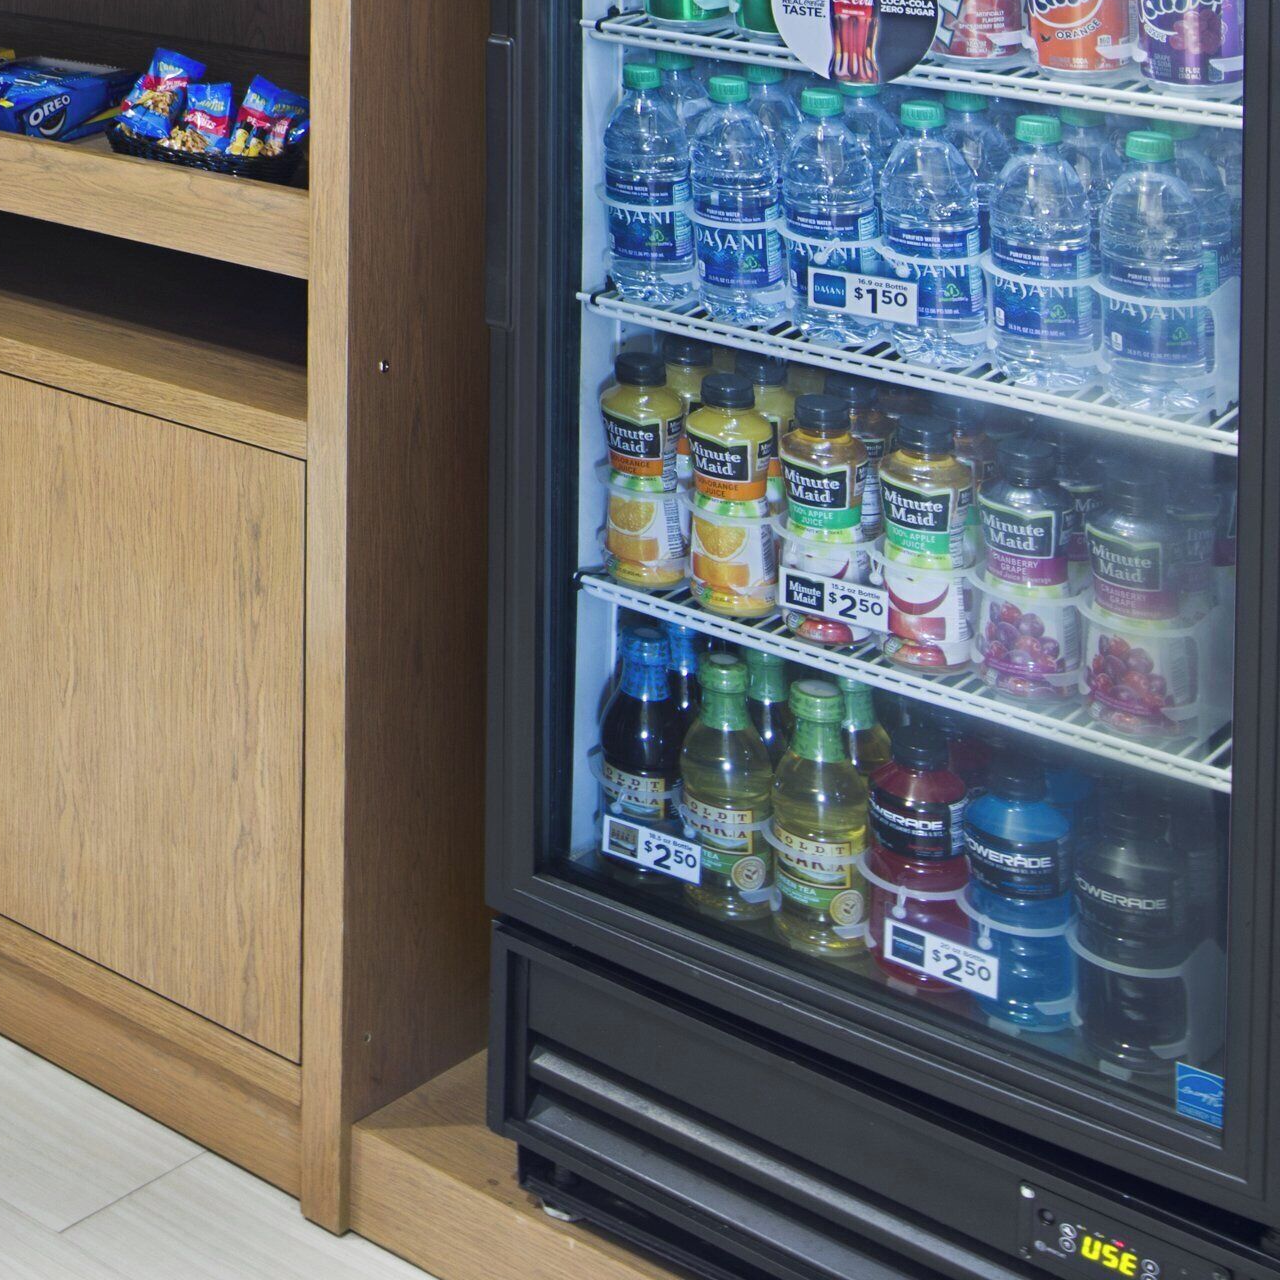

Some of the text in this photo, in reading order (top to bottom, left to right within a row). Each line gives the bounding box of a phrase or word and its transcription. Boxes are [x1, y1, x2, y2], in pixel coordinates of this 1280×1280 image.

[782, 4, 827, 19] TASTE.
[880, 4, 935, 17] ZERO SUGAR
[1055, 18, 1102, 40] ORANGE
[27, 93, 72, 127] OREO
[696, 228, 763, 253] DASANI
[814, 284, 845, 297] DASANI
[857, 278, 873, 287] 16.9
[885, 282, 909, 292] Bottle
[606, 420, 655, 442] Minute
[610, 433, 648, 455] Maid
[691, 441, 742, 463] Minute
[621, 458, 651, 469] ORANGE
[695, 454, 736, 476] Maid
[708, 481, 739, 492] ORANGE
[785, 465, 840, 491] Minute
[790, 482, 834, 504] Maid
[883, 486, 943, 513] Minute
[801, 518, 823, 527] JUICE
[807, 511, 833, 520] APPLE
[890, 505, 937, 528] Maid
[983, 510, 1045, 537] Minute
[891, 524, 936, 544] 100% APPLE
[901, 537, 926, 551] JUICE
[990, 529, 1038, 552] Maid
[1091, 542, 1153, 570] Minute
[999, 561, 1028, 577] GRAPE
[1098, 560, 1147, 584] Maid
[789, 580, 822, 597] Minute
[793, 591, 817, 606] Maid
[831, 583, 846, 592] 15.2
[857, 589, 881, 600] Bottle
[1108, 594, 1137, 609] GRAPE
[1080, 1235, 1137, 1276] USE
